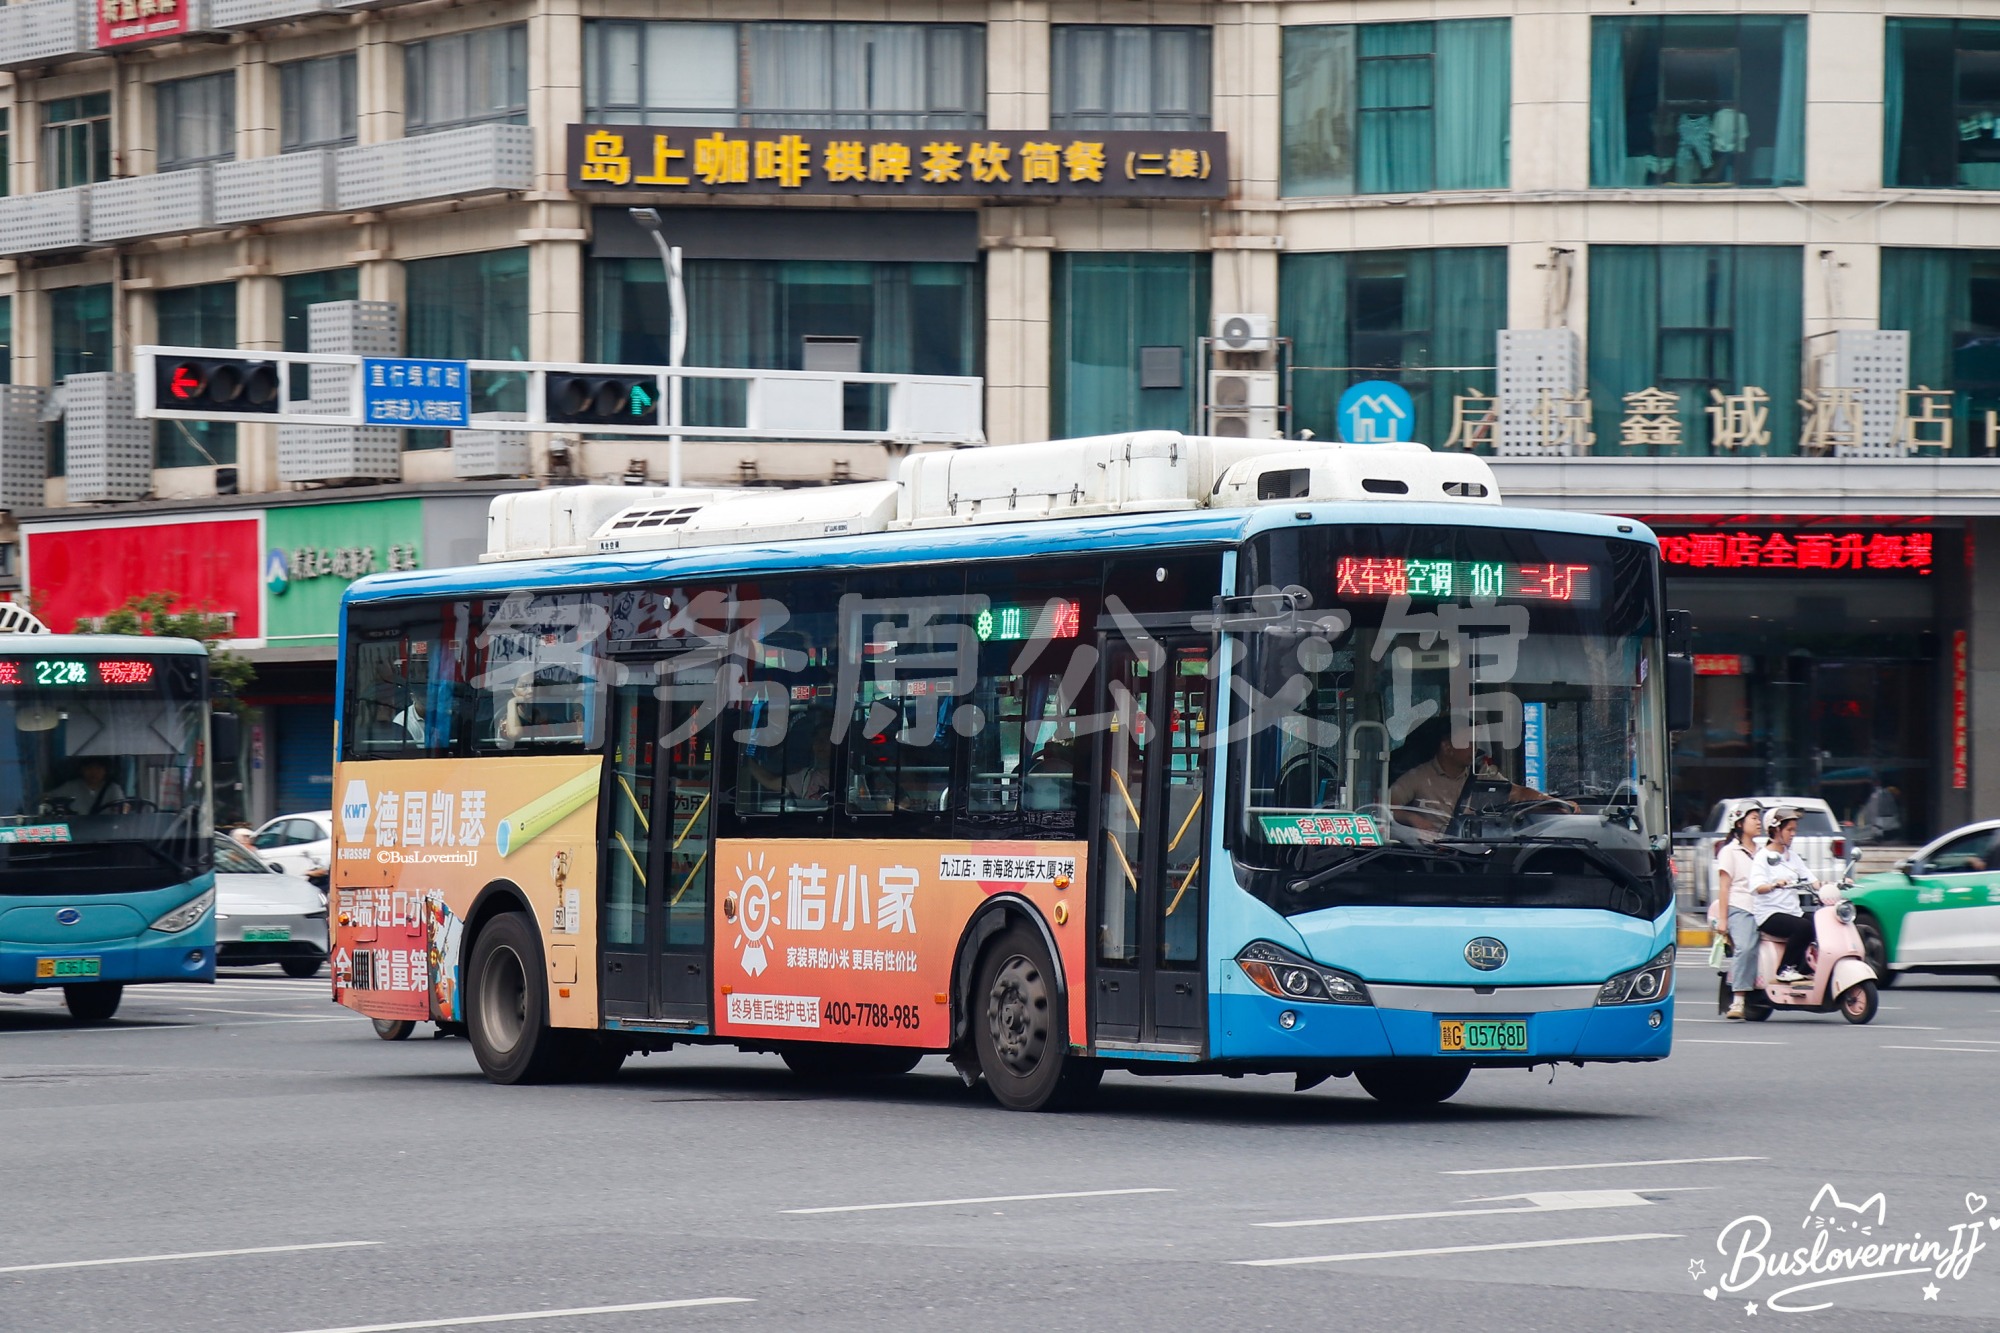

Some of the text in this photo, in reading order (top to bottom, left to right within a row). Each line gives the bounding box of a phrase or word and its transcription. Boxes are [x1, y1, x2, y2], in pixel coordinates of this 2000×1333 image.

[580, 129, 812, 188] 岛上咖啡
[1471, 563, 1504, 597] 101
[1520, 564, 1589, 600] 二七厂
[1001, 608, 1020, 639] 101
[345, 803, 367, 818] KWT
[374, 790, 487, 848] 德国凯瑟
[1296, 817, 1374, 836] 空调开启
[787, 862, 920, 934] 桔小家
[786, 947, 918, 973] 家装界的小米 更具有性价比
[731, 998, 920, 1030] 终身售后维护电话 400-7788-985
[1468, 1025, 1526, 1047] 05768D
